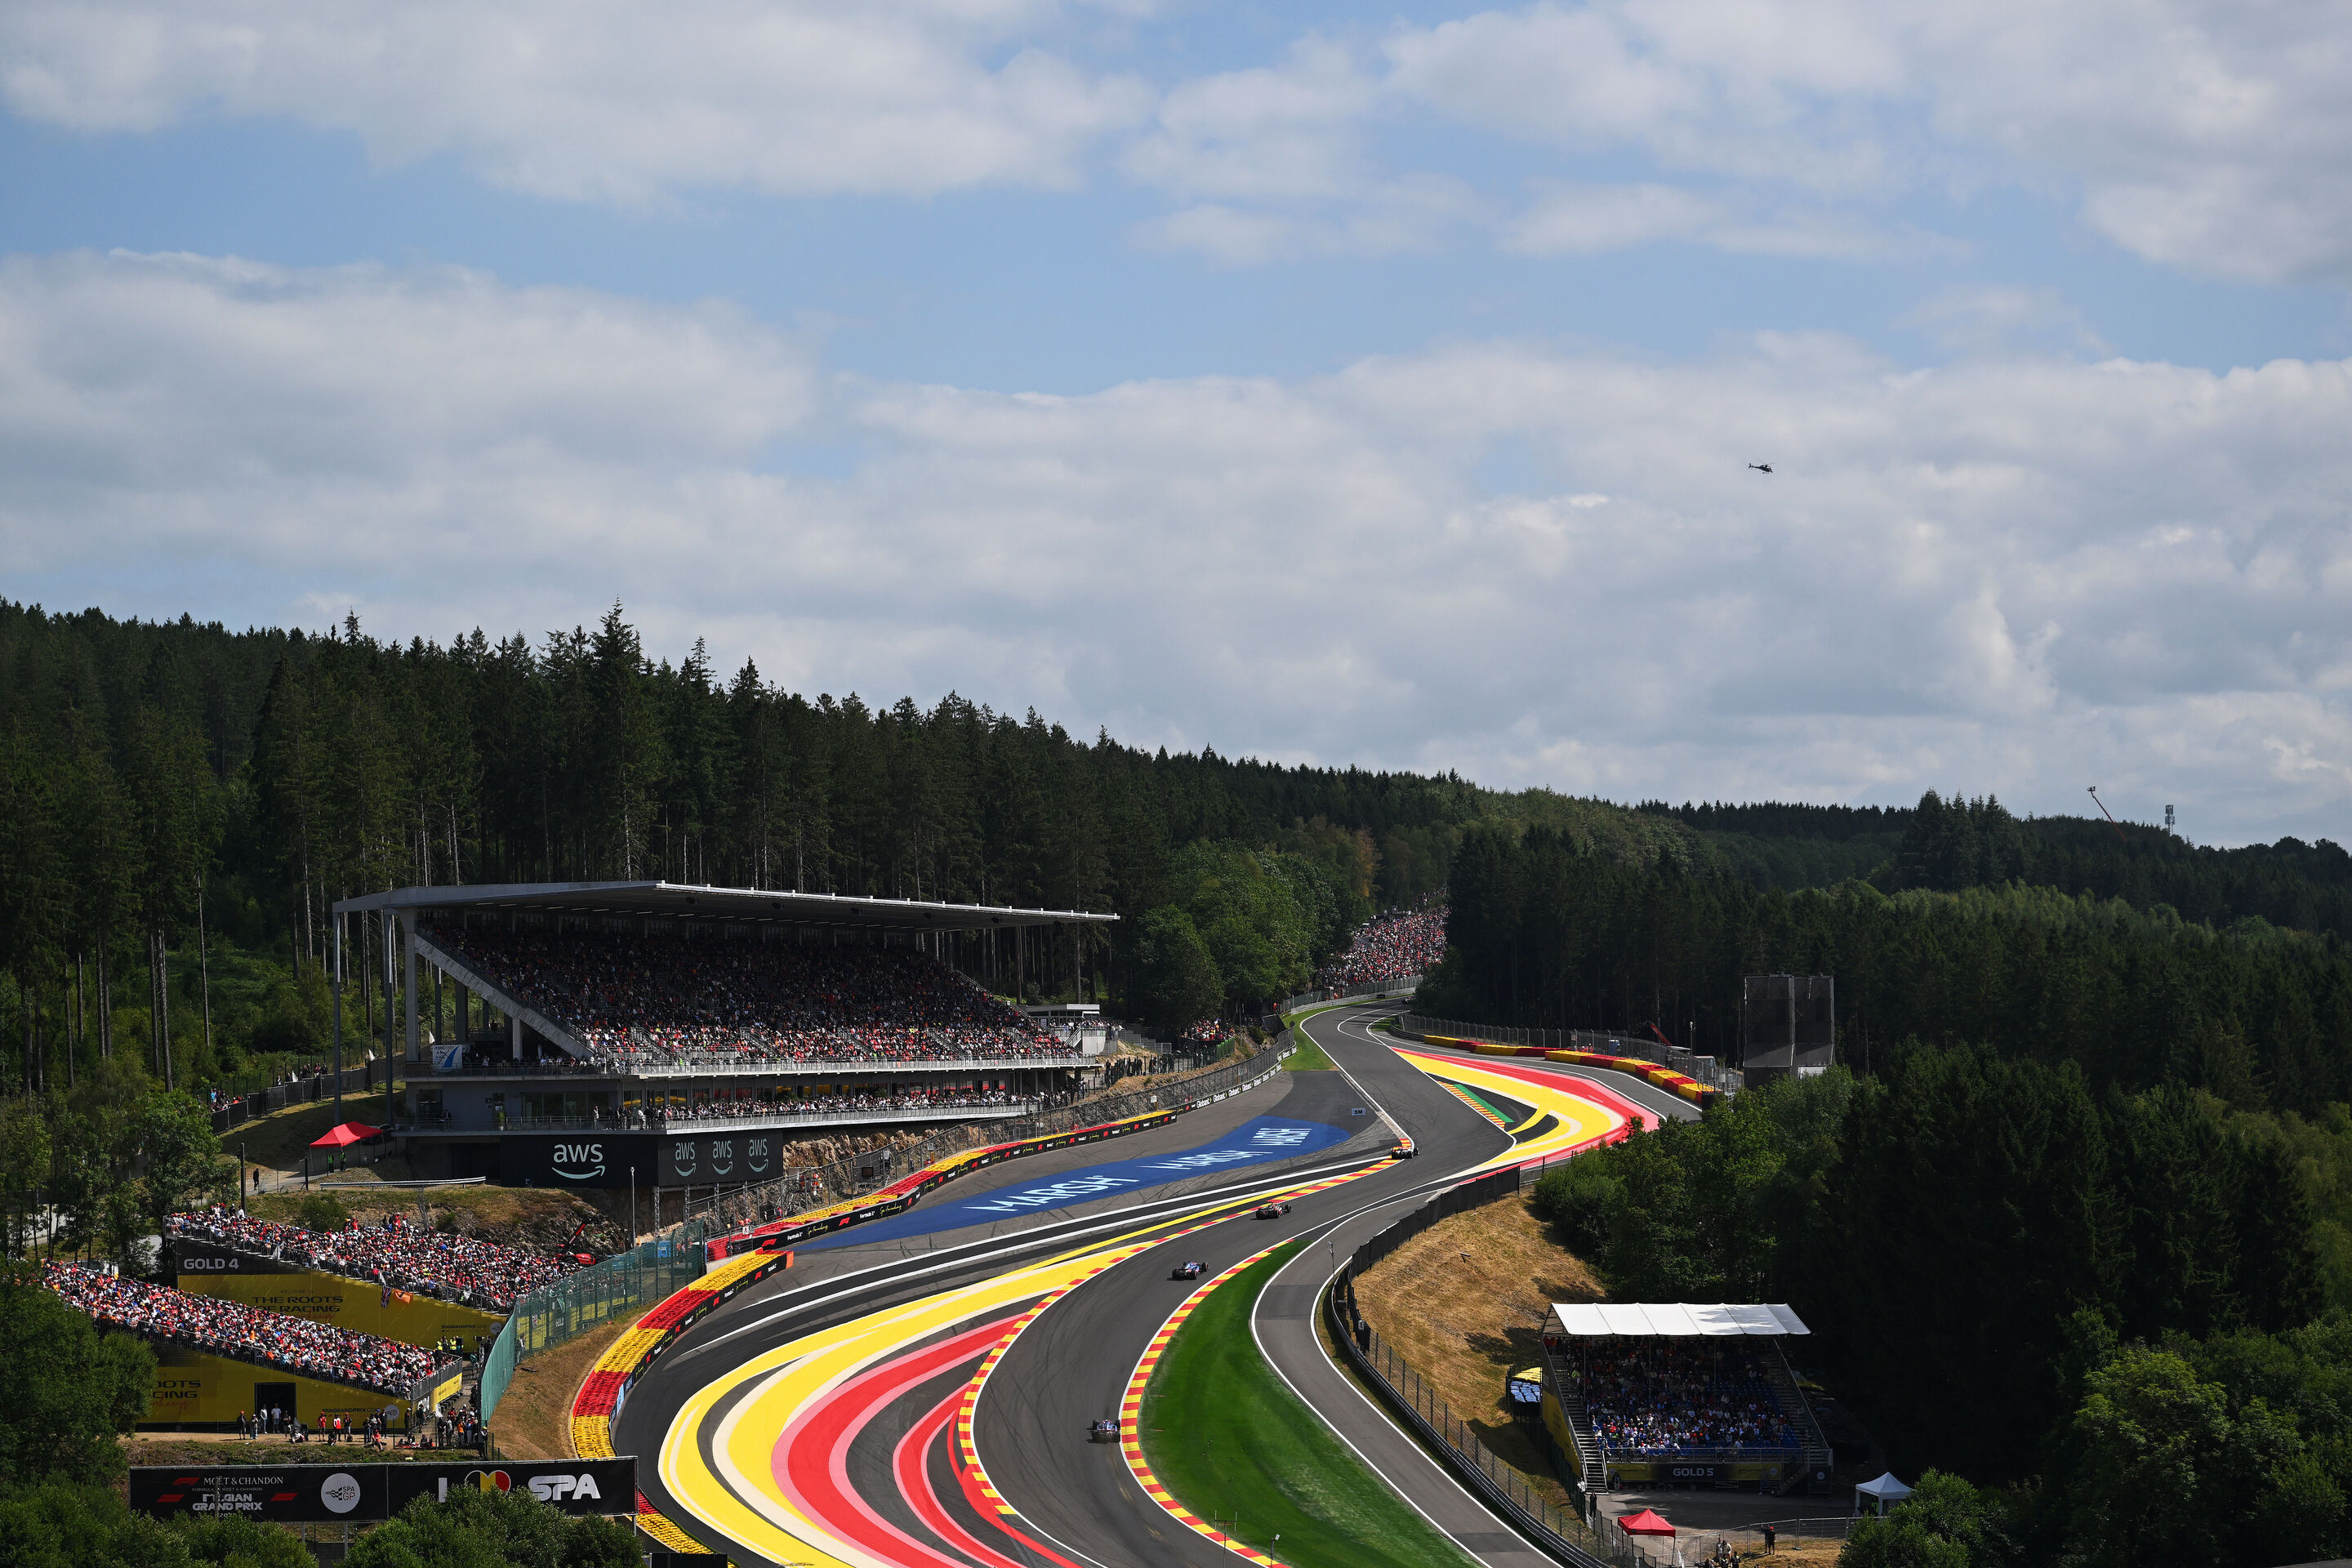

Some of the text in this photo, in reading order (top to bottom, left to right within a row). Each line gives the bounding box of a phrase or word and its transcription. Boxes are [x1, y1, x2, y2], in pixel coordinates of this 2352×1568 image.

[1196, 1098, 1210, 1108] Globant
[1214, 1093, 1225, 1102] Globant
[553, 1143, 603, 1163] aws
[675, 1142, 695, 1160] aws
[712, 1140, 732, 1158] aws
[748, 1138, 768, 1157] aws
[962, 1176, 1140, 1212] MARSH
[184, 1258, 239, 1269] GOLD 4
[1673, 1468, 1713, 1477] GOLD 5
[238, 1477, 284, 1485] CHANDON
[439, 1473, 601, 1503] I SPA
[343, 1492, 355, 1501] GP
[193, 1503, 263, 1511] GRAND PRIX
